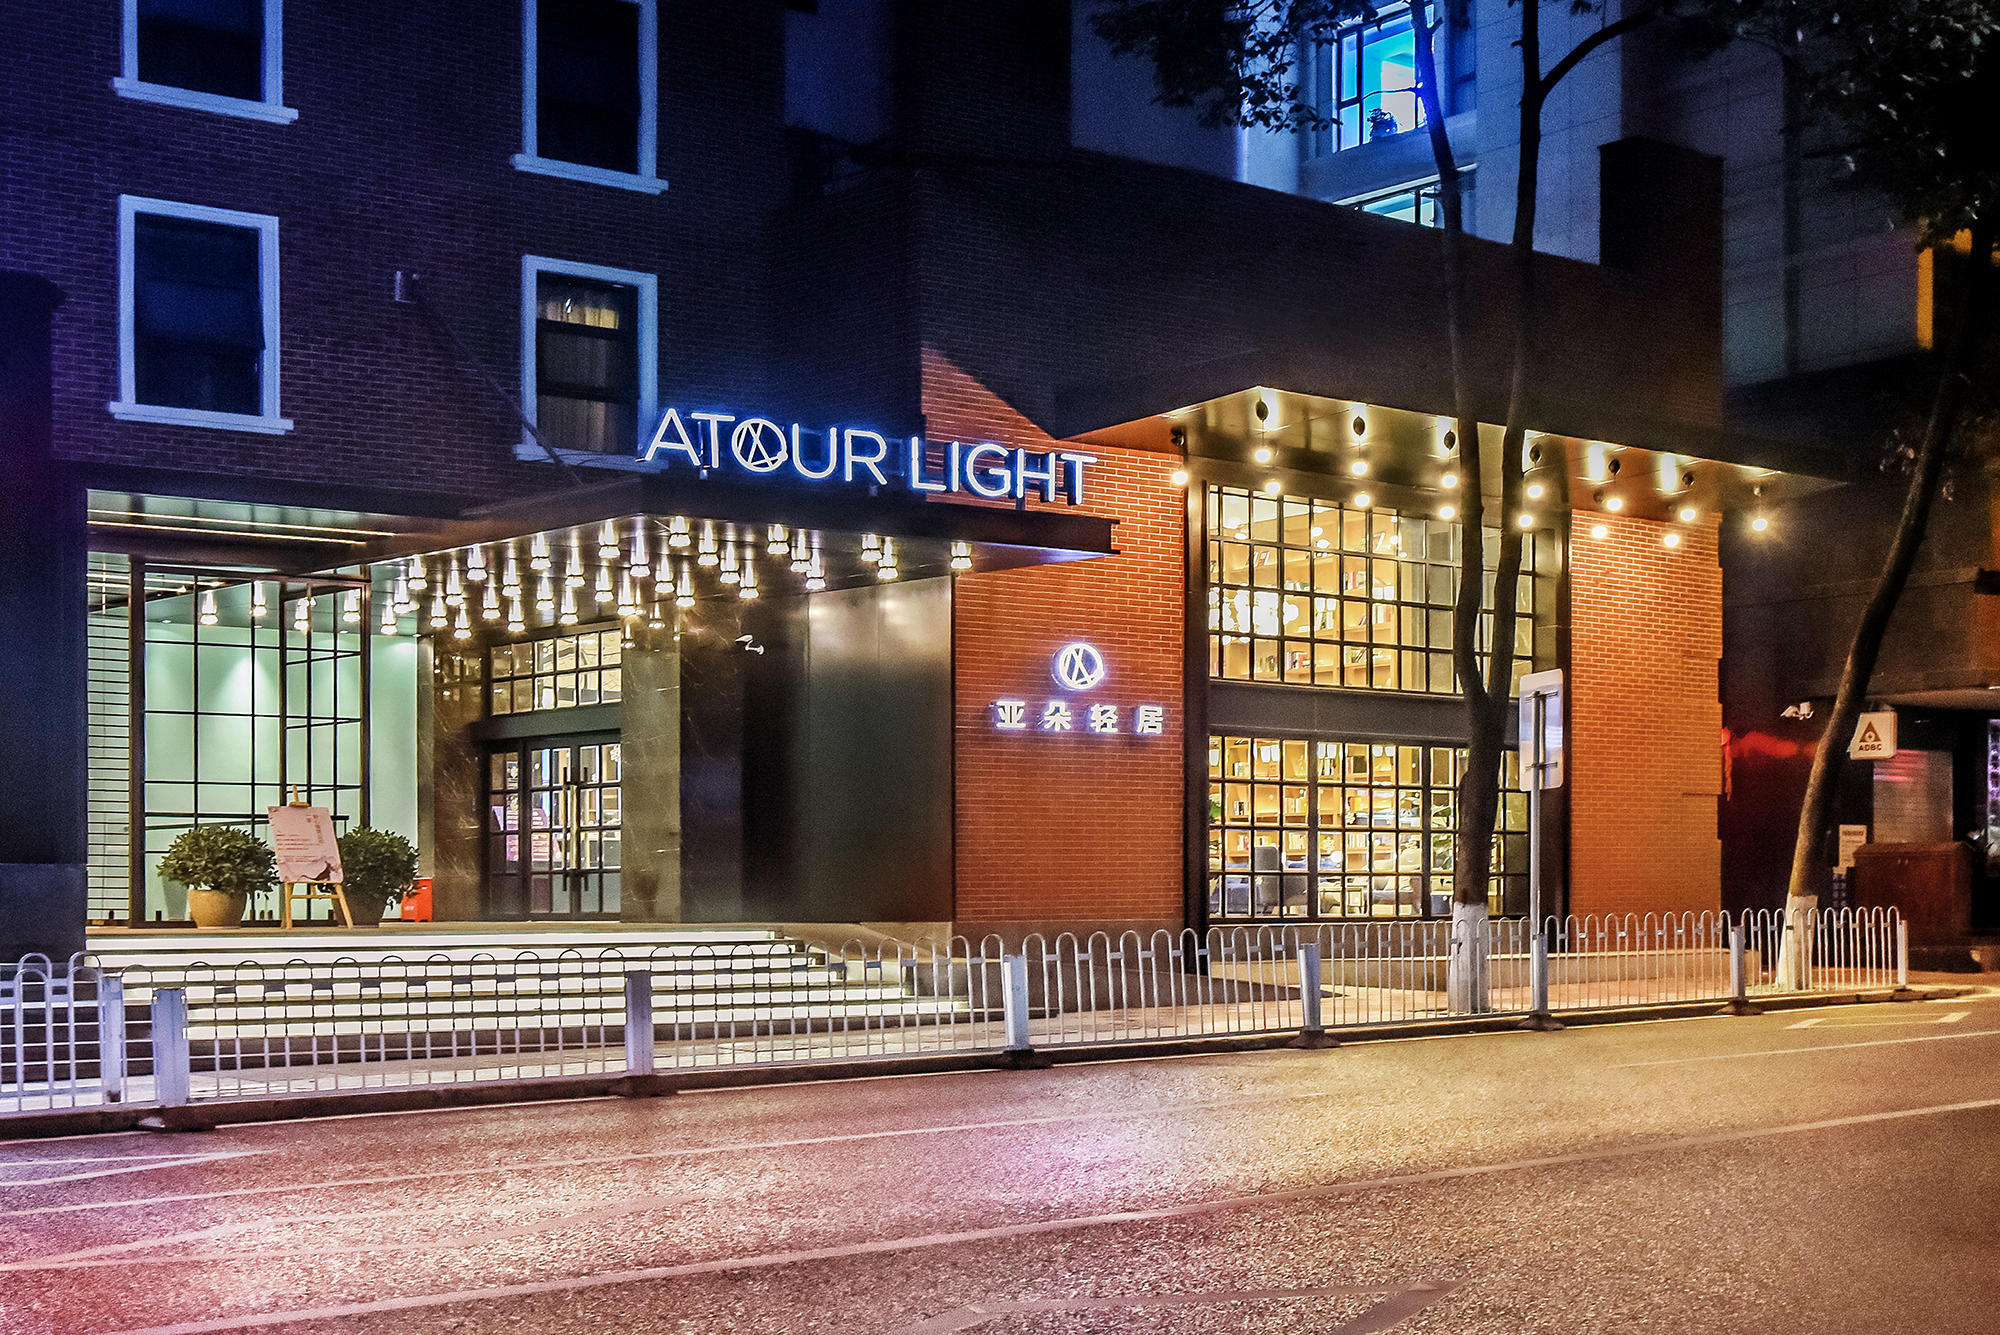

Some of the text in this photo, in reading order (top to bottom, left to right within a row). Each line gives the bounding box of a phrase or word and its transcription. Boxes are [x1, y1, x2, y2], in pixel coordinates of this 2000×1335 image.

[643, 407, 1099, 505] ATOUR LIGHT
[996, 700, 1164, 734] 亚朵轻居
[1857, 743, 1882, 752] ADBC
